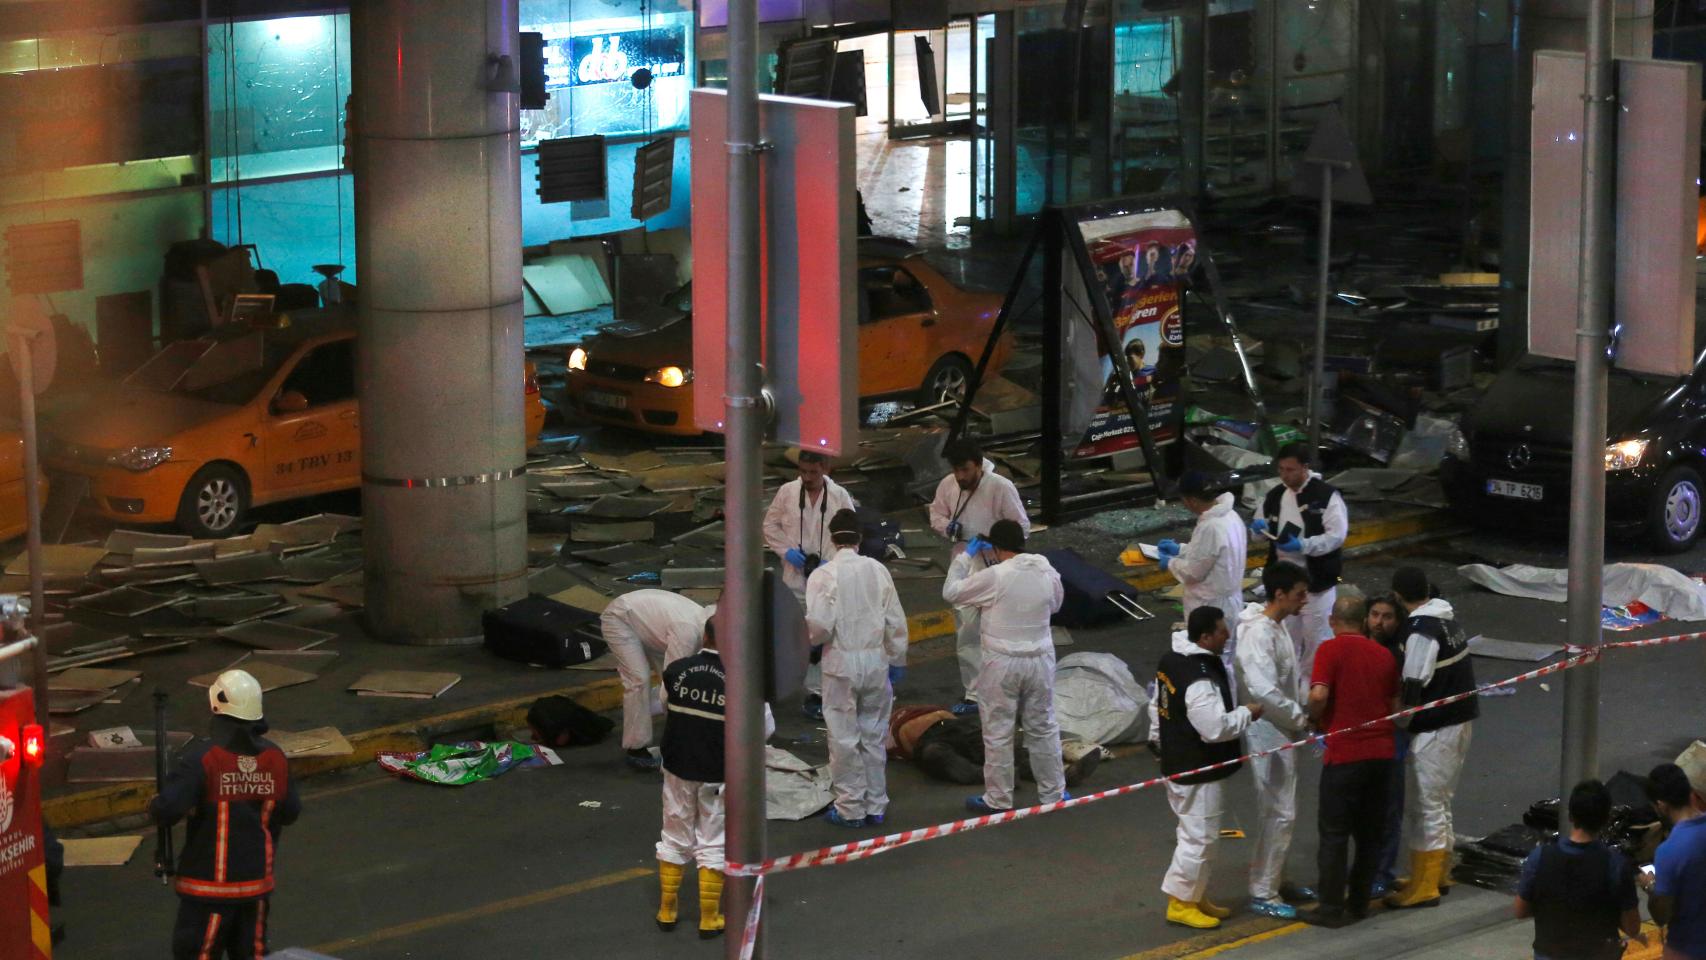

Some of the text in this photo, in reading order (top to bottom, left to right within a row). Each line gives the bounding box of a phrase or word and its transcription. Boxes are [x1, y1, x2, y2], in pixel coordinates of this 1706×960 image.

[673, 671, 687, 691] OLAY
[680, 687, 726, 706] POLİS
[0, 834, 35, 863] KŞEHİR
